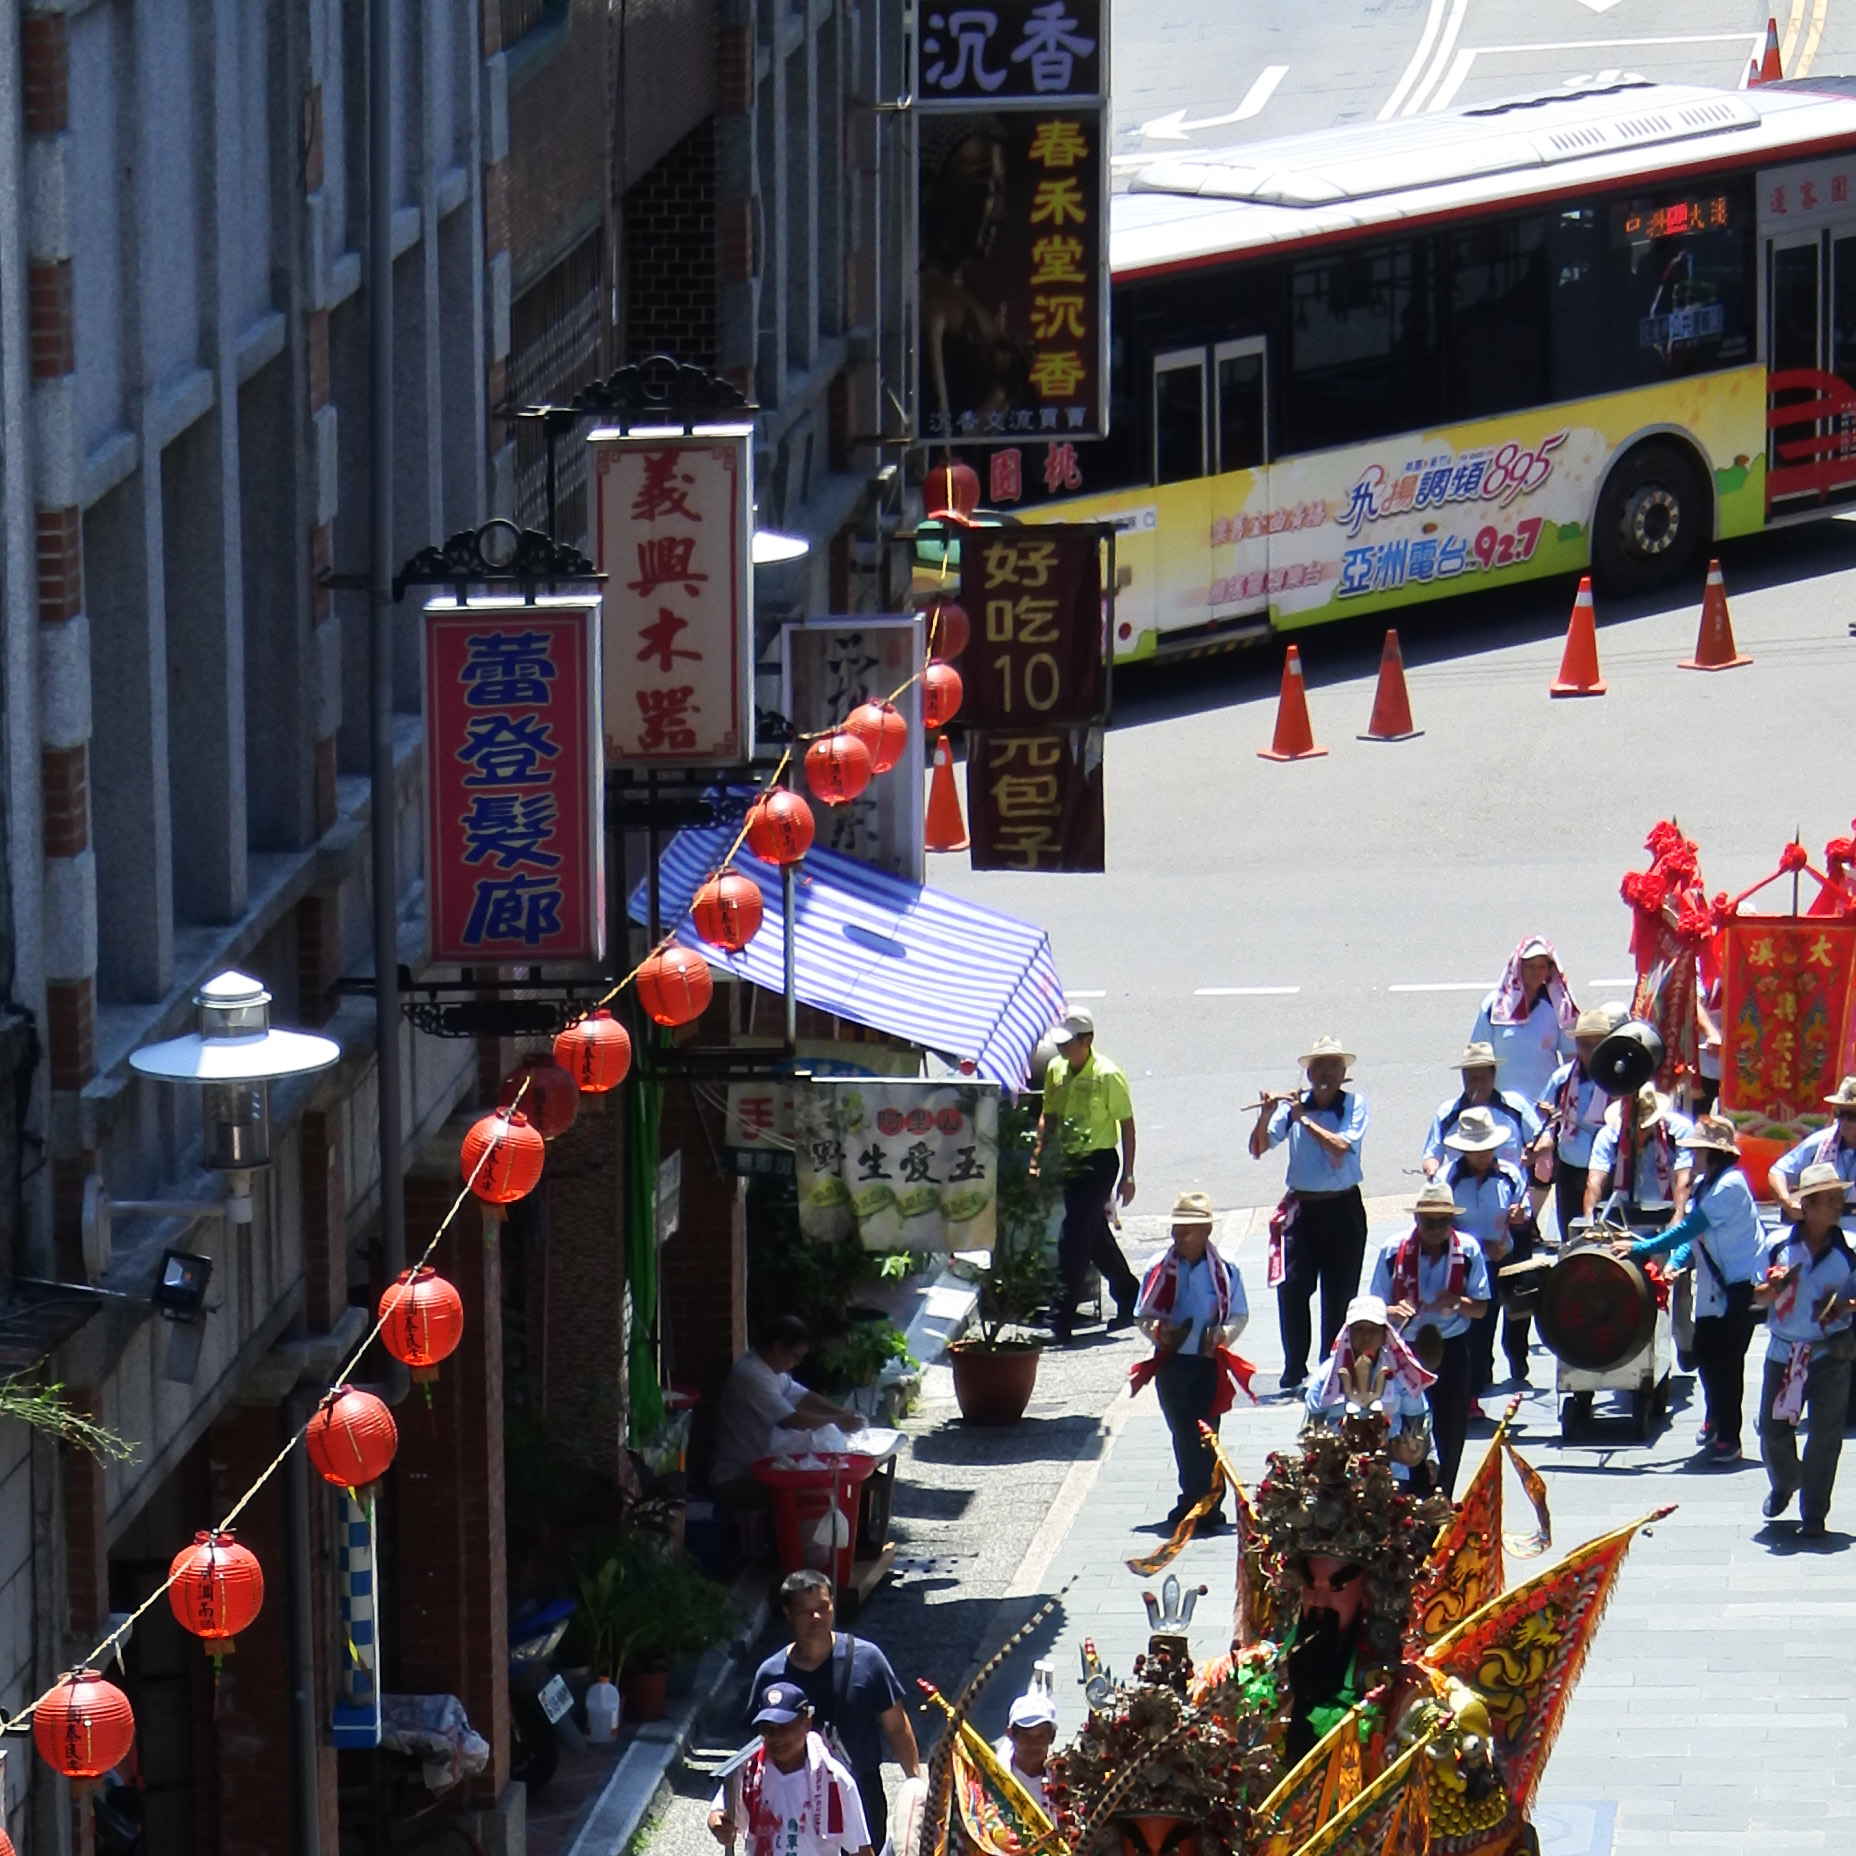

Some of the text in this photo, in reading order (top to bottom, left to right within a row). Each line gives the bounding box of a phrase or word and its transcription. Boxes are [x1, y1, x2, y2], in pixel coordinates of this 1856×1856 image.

[924, 2, 1096, 92] 沉香
[1029, 120, 1089, 397] 春禾堂沉香
[627, 451, 709, 749] 義興木器
[1338, 535, 1468, 598] 亞洲電台
[1473, 516, 1542, 571] 92.7
[456, 631, 565, 945] 蕾登髮廊
[810, 1139, 986, 1185] 野生愛玉
[876, 1108, 963, 1137] 阿里山
